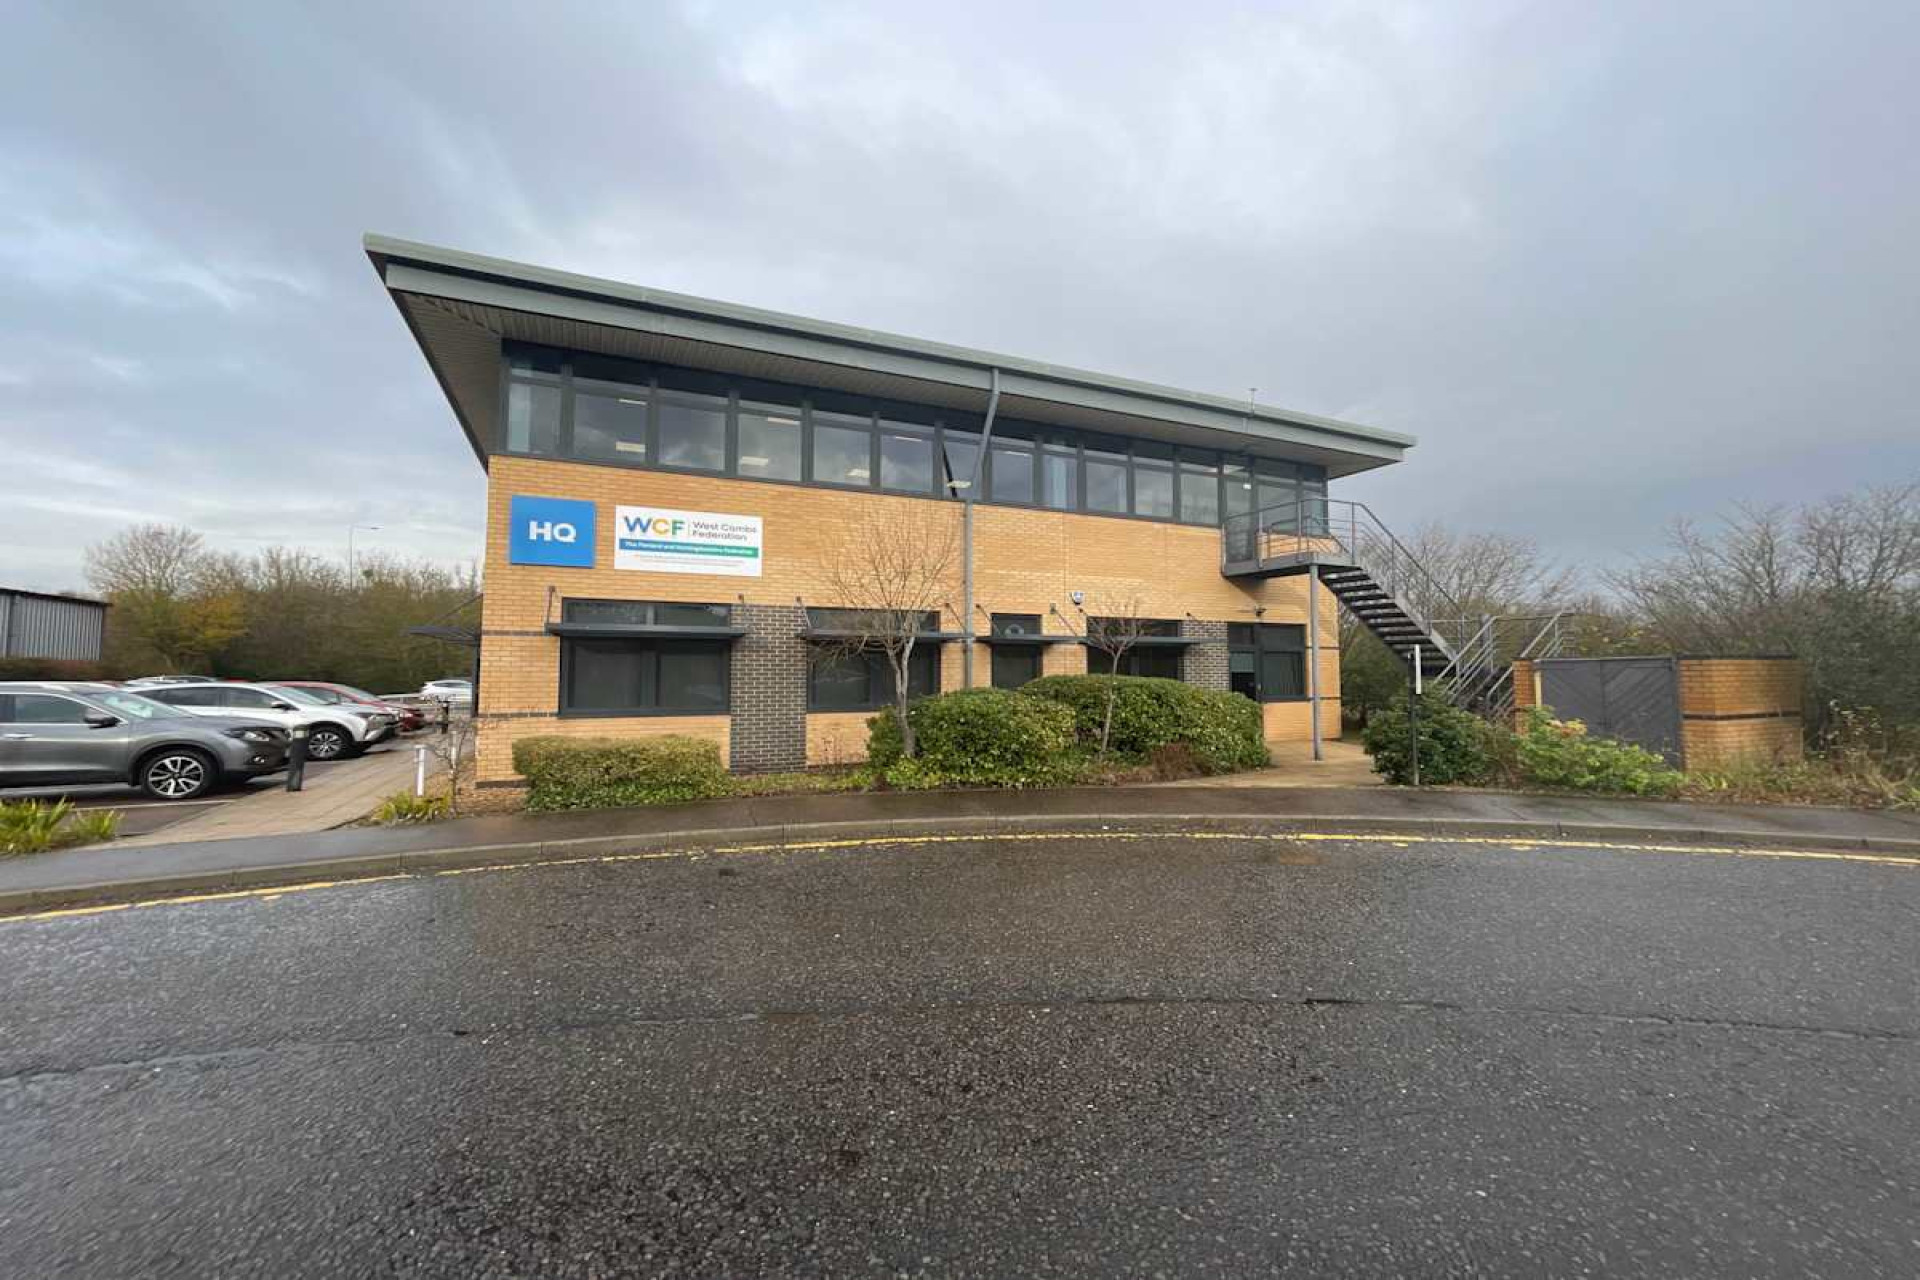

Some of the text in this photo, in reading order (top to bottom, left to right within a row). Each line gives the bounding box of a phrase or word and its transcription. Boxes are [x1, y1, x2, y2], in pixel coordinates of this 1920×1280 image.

[529, 521, 577, 542] HQ
[624, 516, 685, 535] WCF
[692, 522, 719, 532] West
[692, 530, 748, 541] Federation
